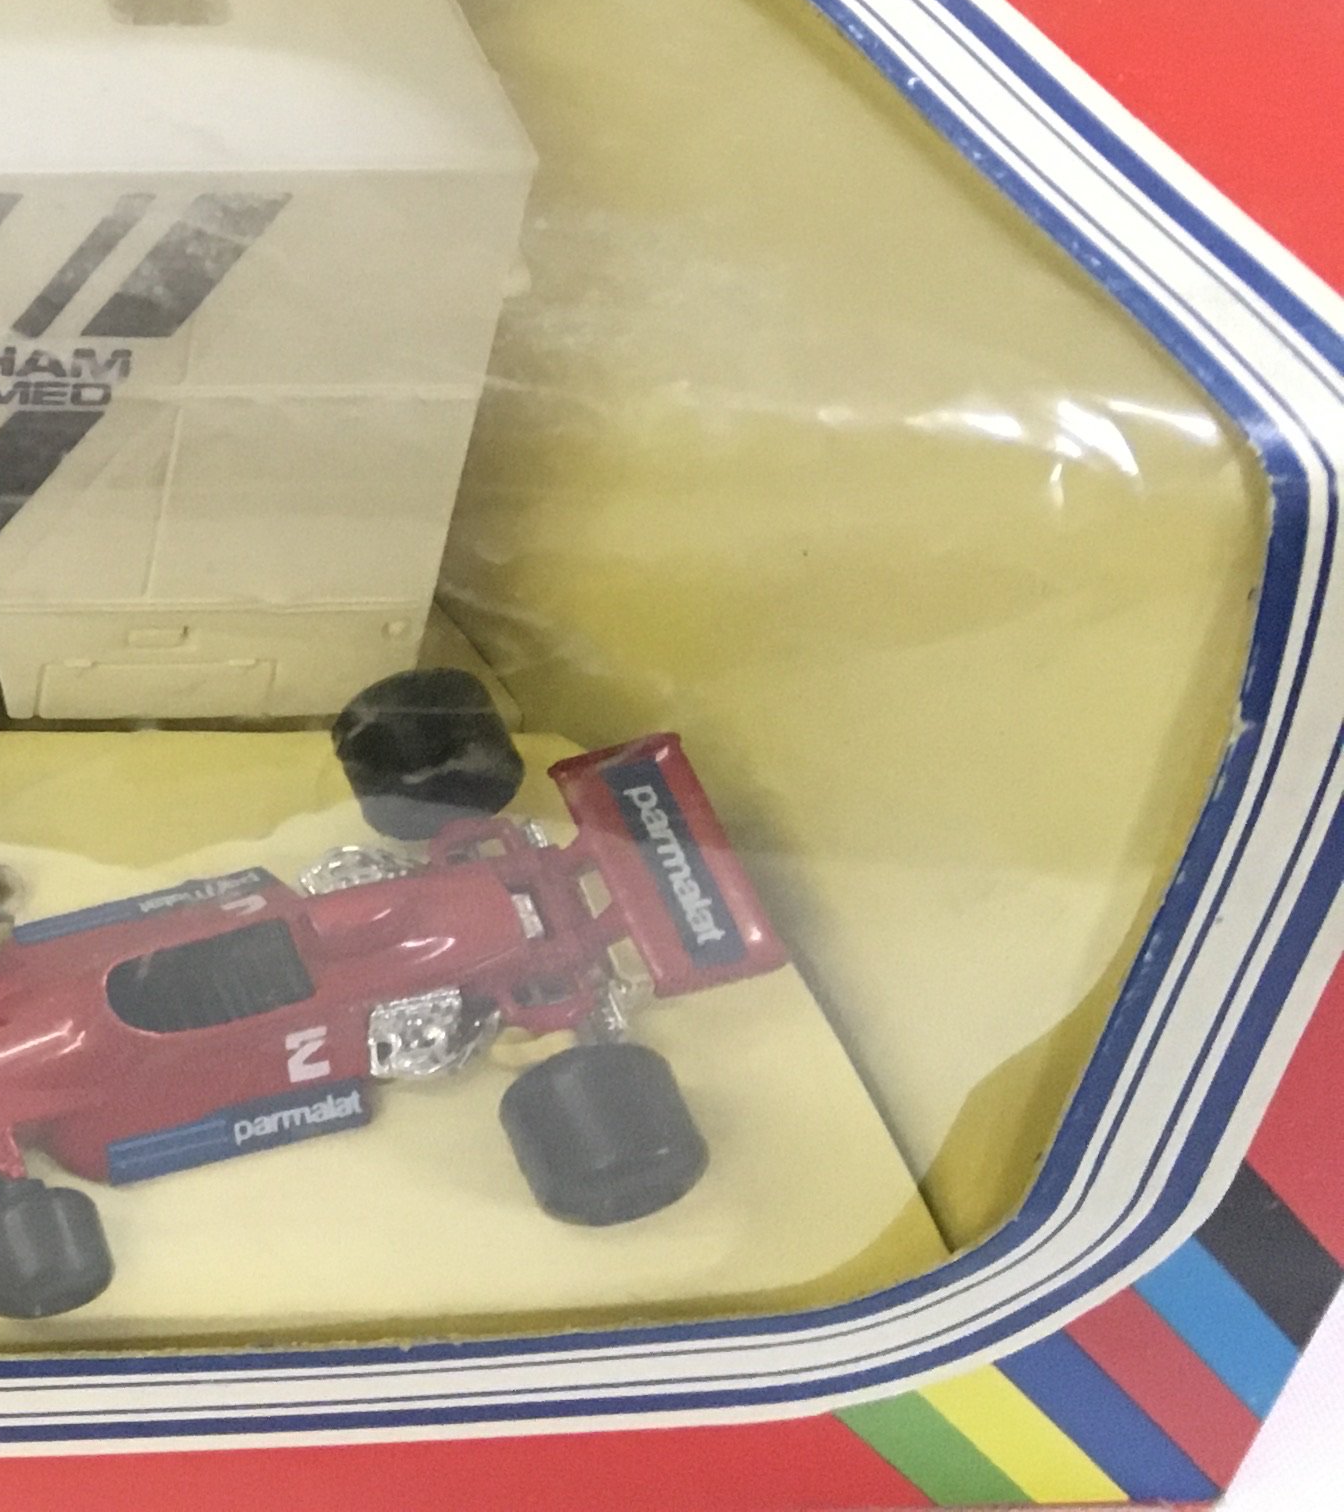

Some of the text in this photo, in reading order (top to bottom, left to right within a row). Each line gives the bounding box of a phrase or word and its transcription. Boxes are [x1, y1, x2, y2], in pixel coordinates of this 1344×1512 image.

[622, 784, 726, 946] parmalat
[285, 1026, 330, 1082] 2
[234, 1091, 362, 1145] parmalat
